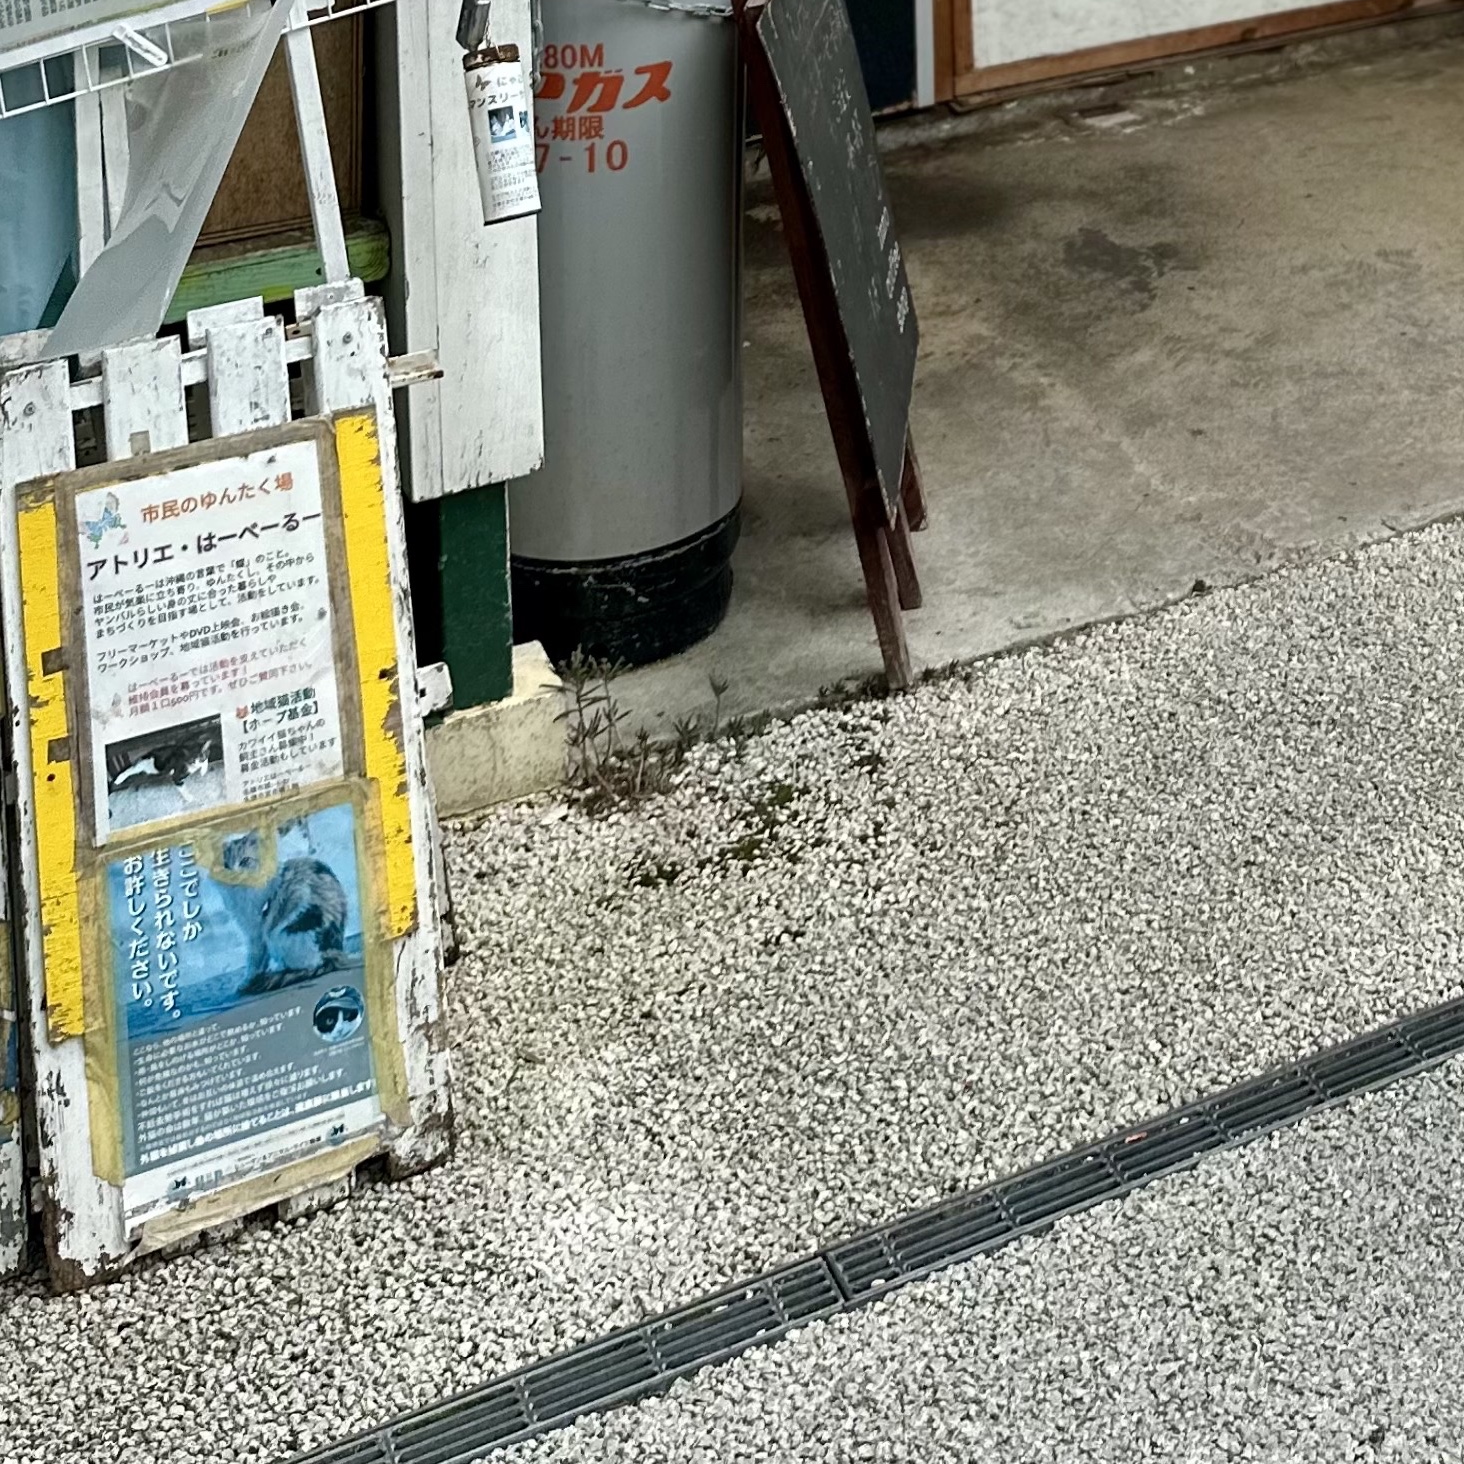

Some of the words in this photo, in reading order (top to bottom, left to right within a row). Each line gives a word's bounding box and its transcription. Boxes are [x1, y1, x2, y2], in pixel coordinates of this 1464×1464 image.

[87, 512, 322, 580] アトリエ・はーべーるー
[141, 472, 294, 524] 市民のゆんたく場
[123, 855, 153, 1008] お許しください。
[150, 846, 181, 1020] 生きられないです。
